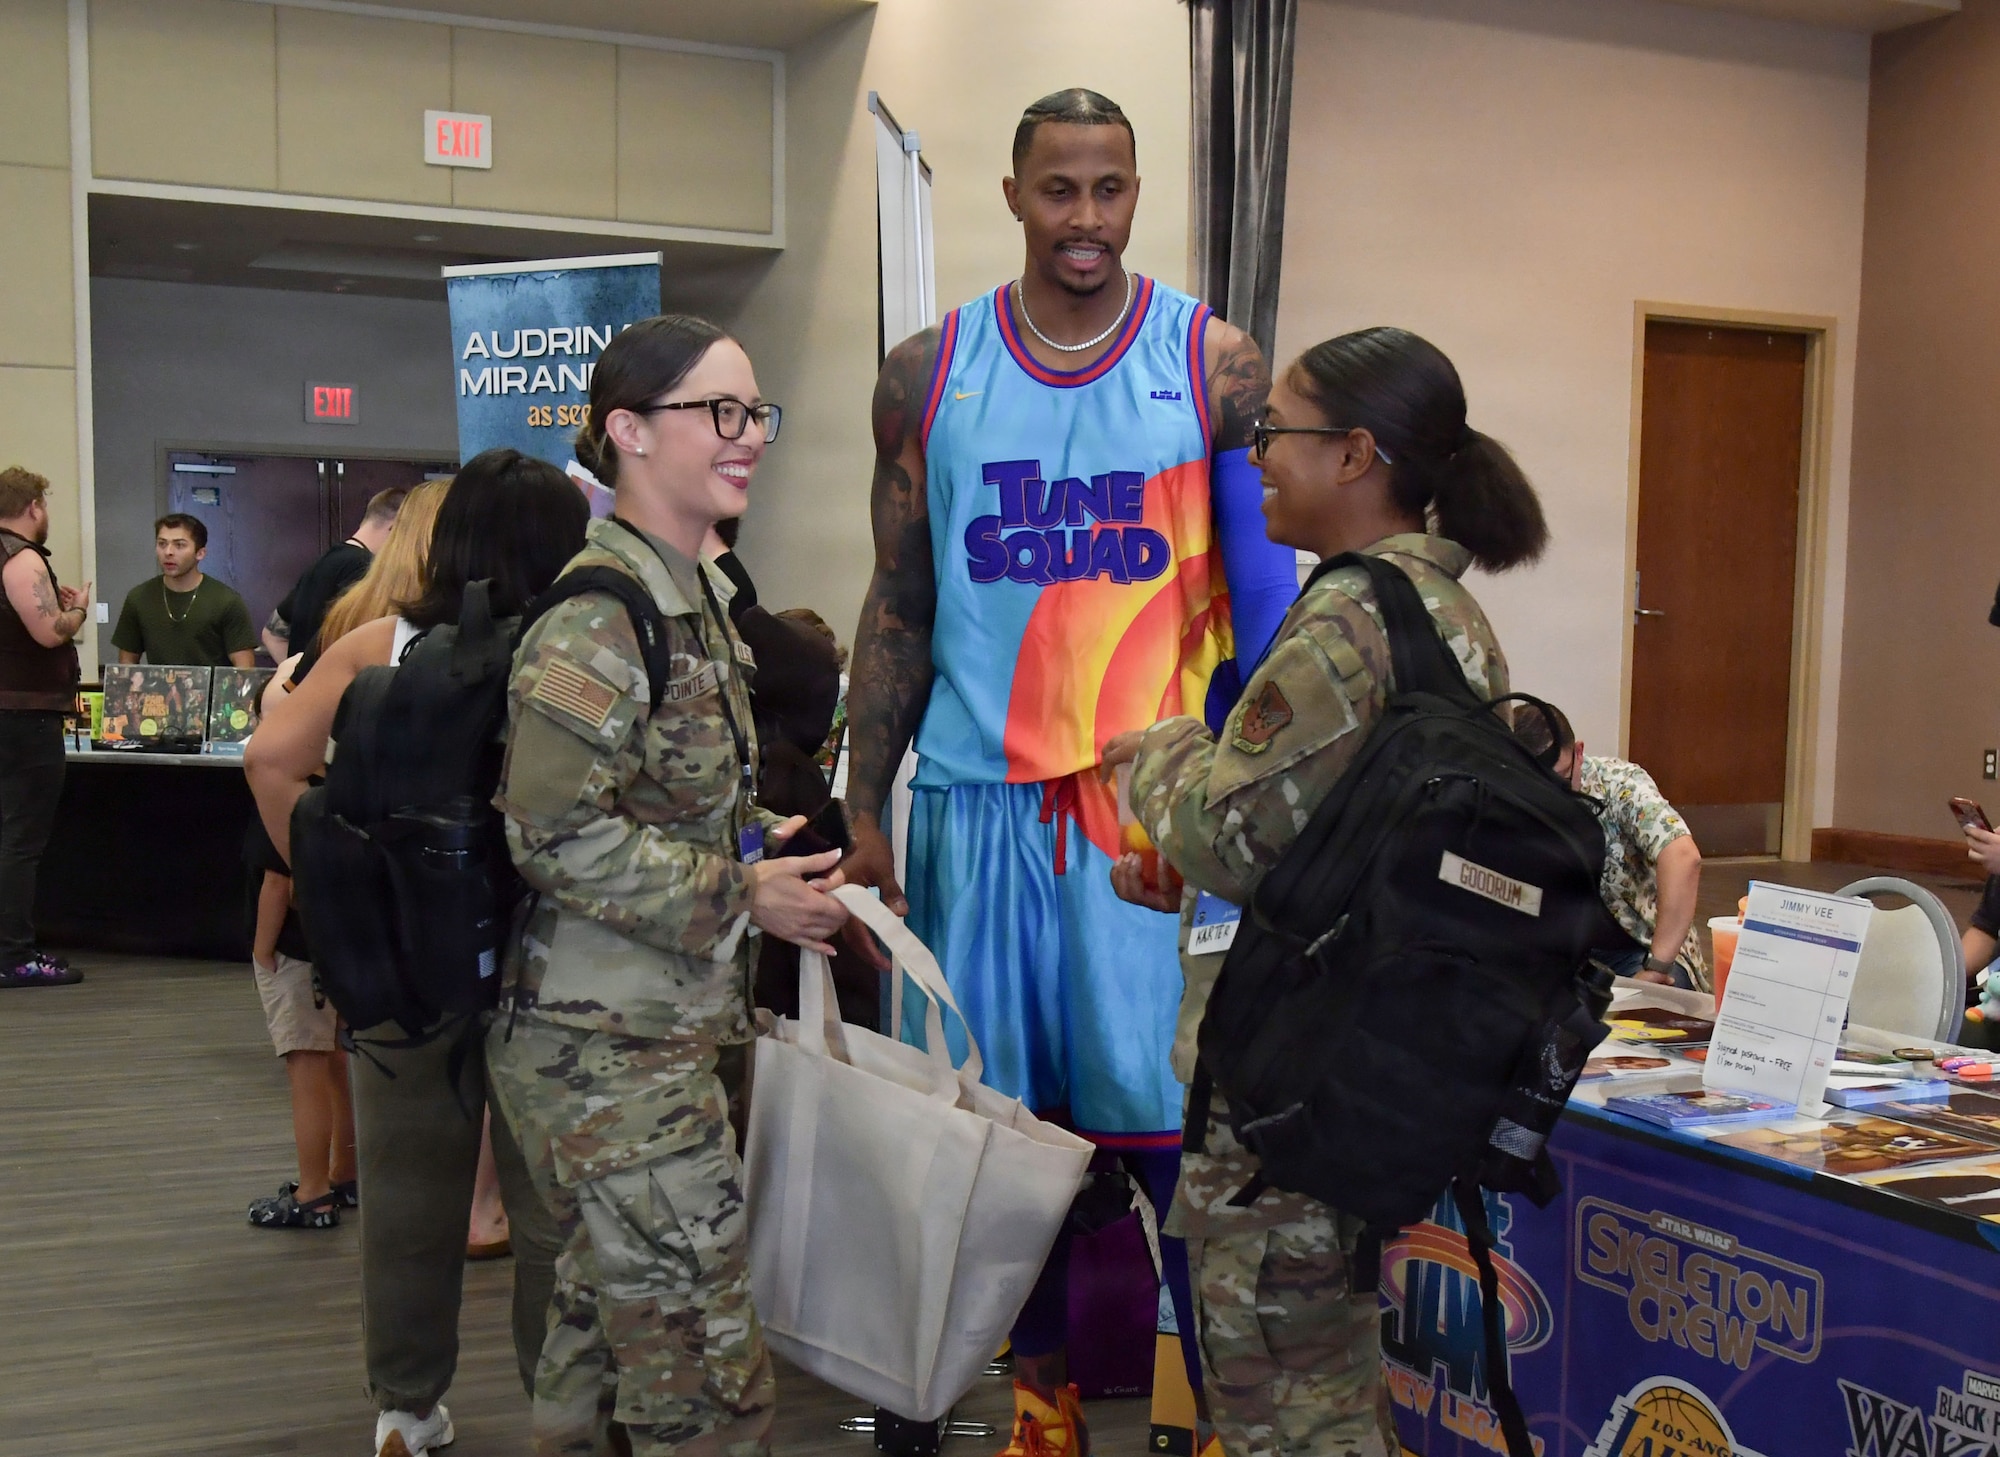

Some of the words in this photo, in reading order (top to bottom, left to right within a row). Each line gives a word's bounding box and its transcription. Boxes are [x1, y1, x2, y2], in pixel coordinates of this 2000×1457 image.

[436, 118, 484, 159] EXIT
[462, 323, 632, 361] AUDRIN
[459, 362, 598, 396] MIRAN
[313, 385, 352, 419] EXIT
[527, 404, 553, 427] as
[982, 459, 1145, 529] TUNE
[964, 514, 1171, 586] SQUAD
[1460, 861, 1522, 907] GOODRUM
[1780, 899, 1811, 914] JIMMY
[1814, 907, 1834, 919] VEE
[1195, 923, 1231, 948] KARTER
[1717, 1041, 1738, 1056] Signed
[1775, 1058, 1793, 1071] FREE
[1656, 1216, 1693, 1239] STAR
[1693, 1226, 1732, 1251] WARS
[1587, 1212, 1808, 1341] SKELETON
[1627, 1282, 1758, 1371] CREW
[1650, 1418, 1685, 1443] LOS
[1938, 1392, 1985, 1433] BLACK
